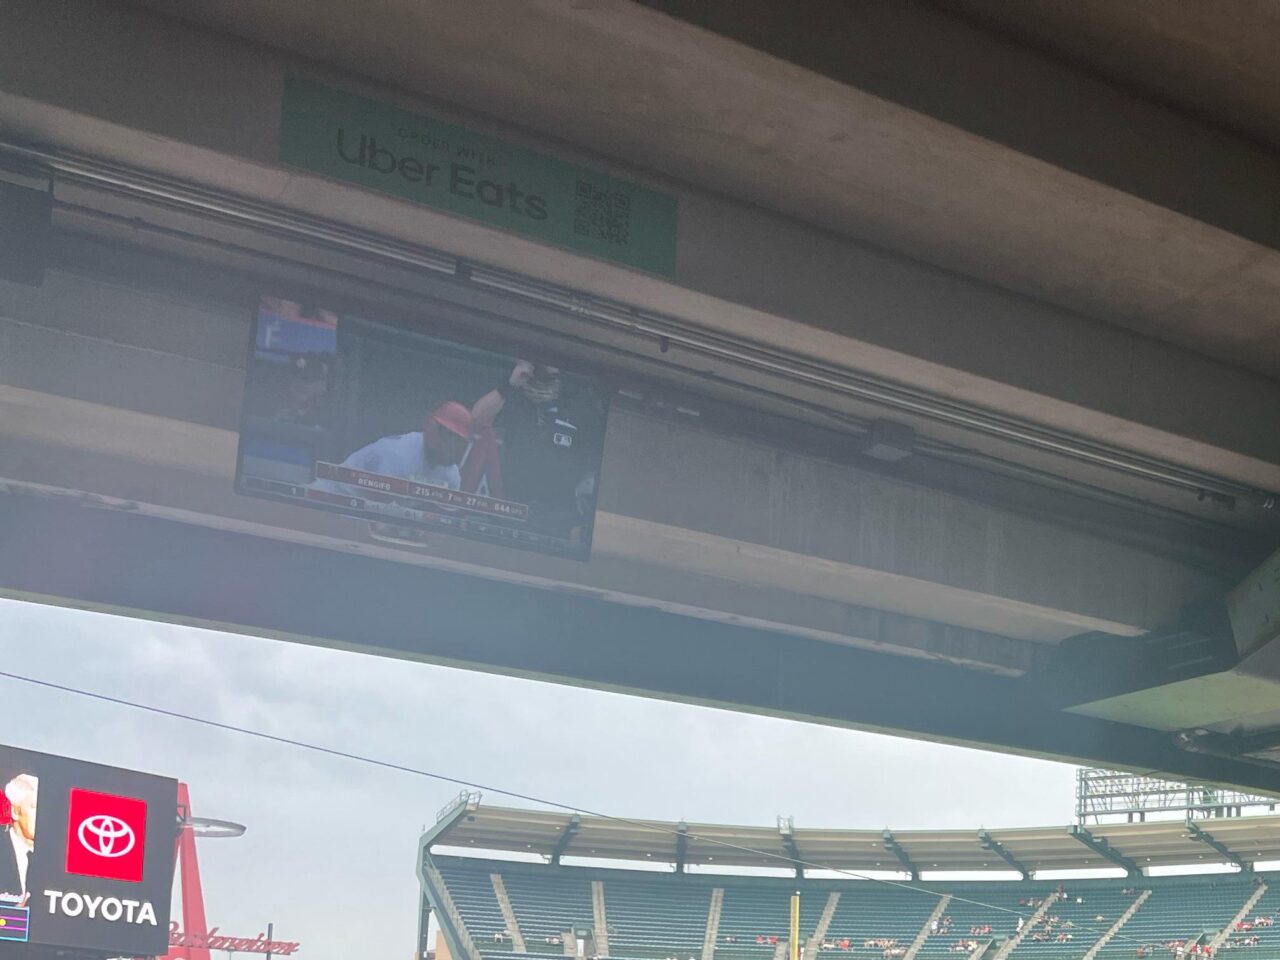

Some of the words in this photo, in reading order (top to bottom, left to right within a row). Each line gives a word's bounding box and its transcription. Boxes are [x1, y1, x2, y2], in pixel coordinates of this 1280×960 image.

[337, 128, 440, 186] Uber
[450, 162, 548, 220] Eats
[44, 889, 158, 926] TOYOTA
